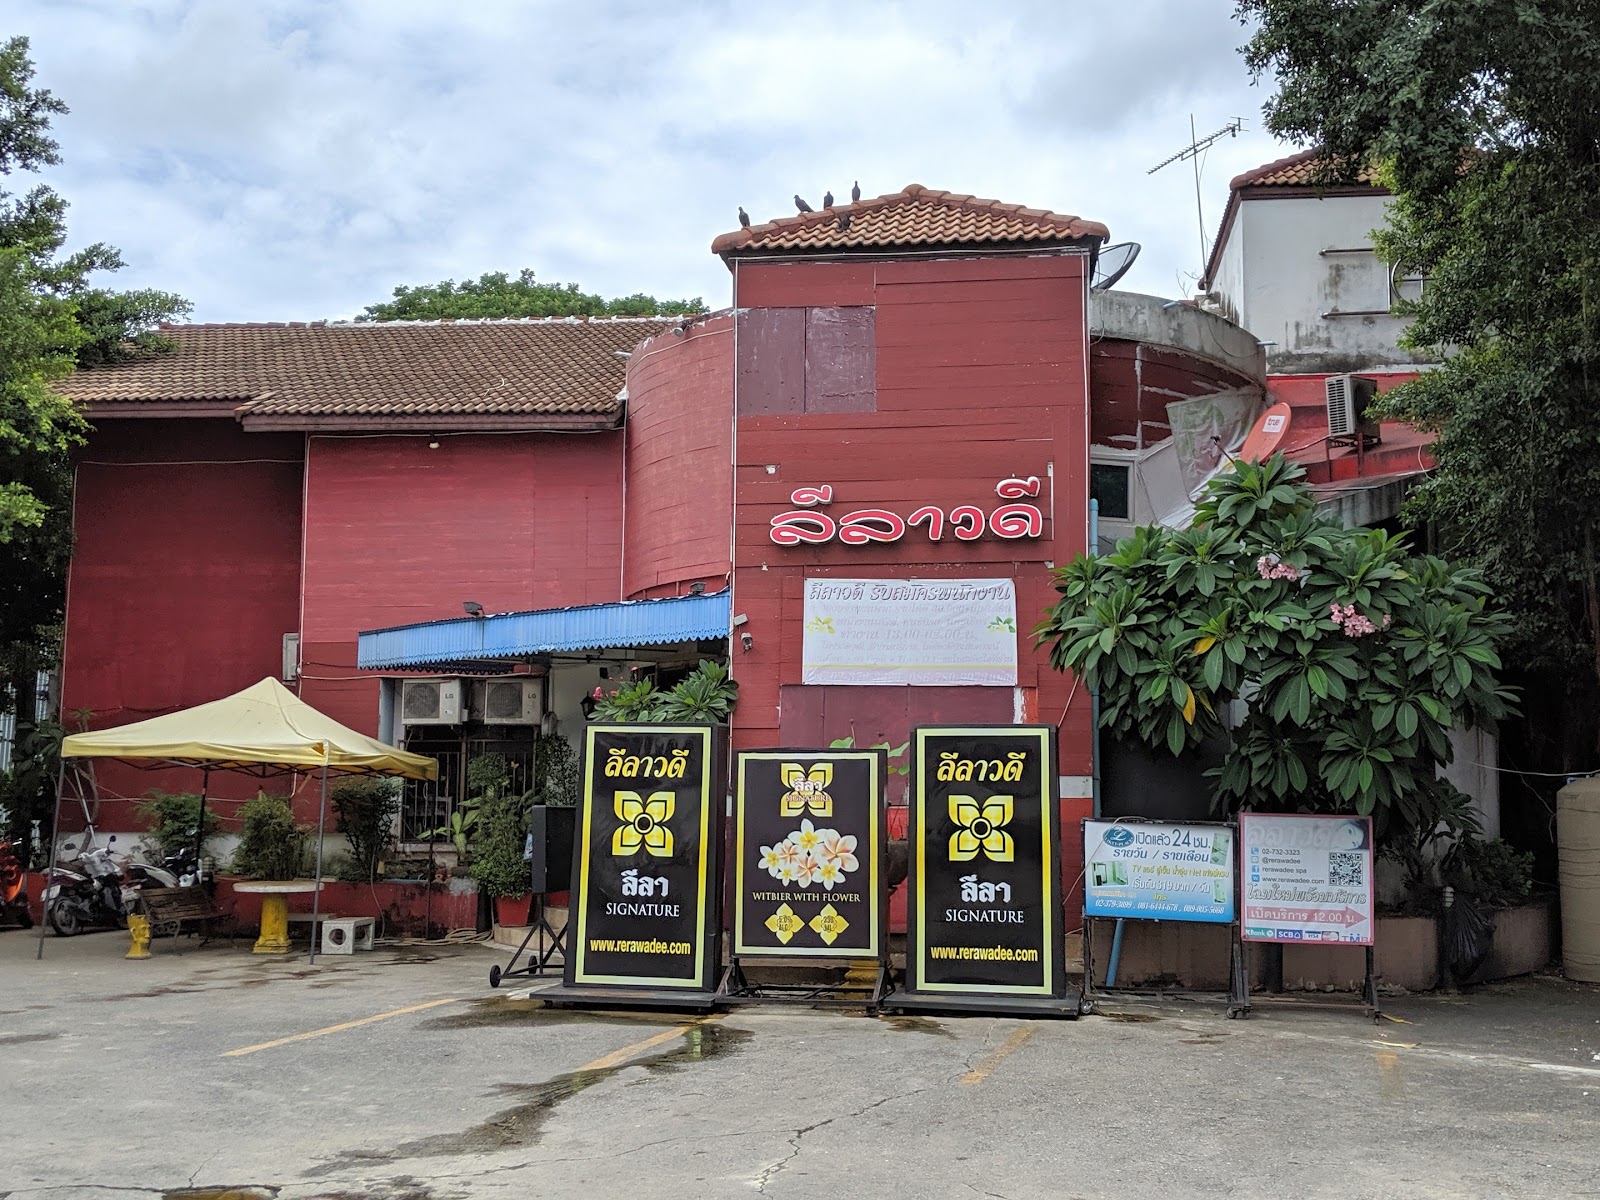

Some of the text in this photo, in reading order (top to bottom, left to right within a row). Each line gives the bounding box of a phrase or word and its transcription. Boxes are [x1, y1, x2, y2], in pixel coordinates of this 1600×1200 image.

[769, 476, 1043, 546] ลีลาวดี
[809, 581, 1011, 602] ลีลาวดี รับสมัครพนักงาน
[604, 748, 690, 778] ลีลาวดี
[937, 752, 1026, 782] ลีลาวดี
[786, 795, 830, 803] SIGNATURE
[1136, 830, 1170, 846] เปิดแล้ว
[1172, 828, 1191, 847] 24
[1193, 837, 1211, 849] ชม.
[1113, 846, 1148, 859] รายวัน
[1162, 849, 1210, 862] รายเดือน
[1262, 857, 1301, 865] @rerawadee
[621, 868, 670, 898] ลีลา
[959, 873, 1011, 904] ลีลา
[1262, 876, 1325, 885] www.rerawadee.com
[752, 891, 861, 902] WITBIER WITH FLOWER
[605, 902, 680, 918] SIGNATURE
[945, 908, 1025, 924] SIGNATURE
[1250, 907, 1358, 923] เปิดบริการ 12.00 น.
[1278, 930, 1293, 939] SCB
[590, 937, 692, 955] www.rerawadee.com
[930, 944, 1039, 963] www.rerawadee.com
